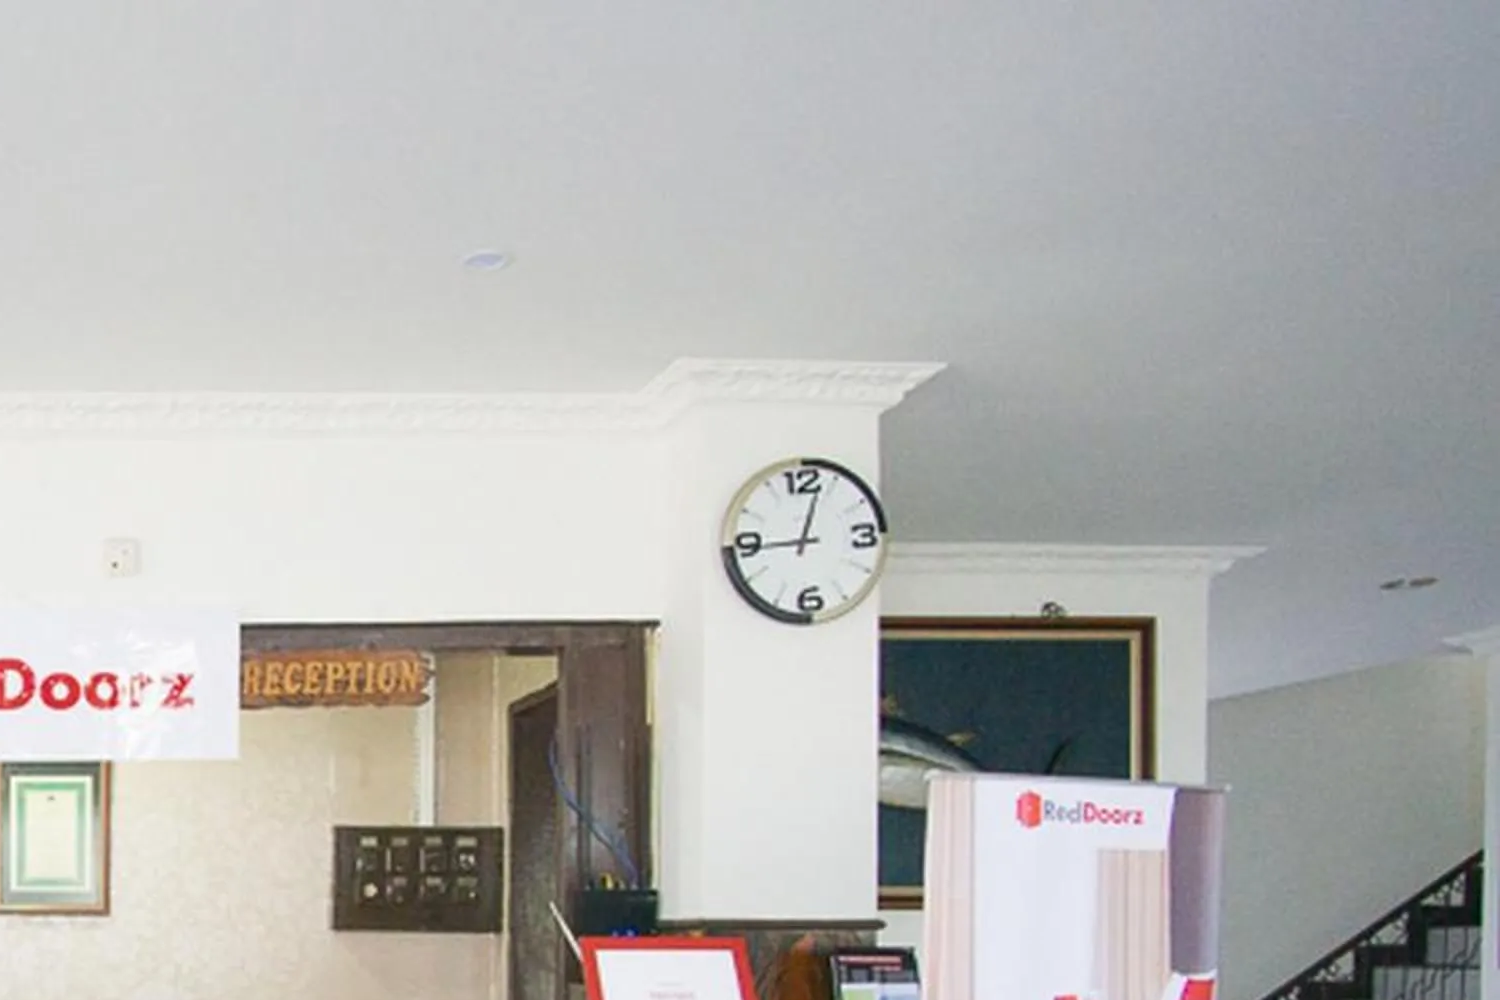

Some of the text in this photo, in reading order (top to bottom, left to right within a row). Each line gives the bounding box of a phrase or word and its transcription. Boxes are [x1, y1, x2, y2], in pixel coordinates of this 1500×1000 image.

[784, 469, 822, 495] 12
[735, 532, 762, 558] 9
[851, 523, 878, 549] 3
[797, 586, 824, 612] 6
[243, 659, 420, 696] RECEPTION
[1043, 800, 1144, 825] RedDoorz
